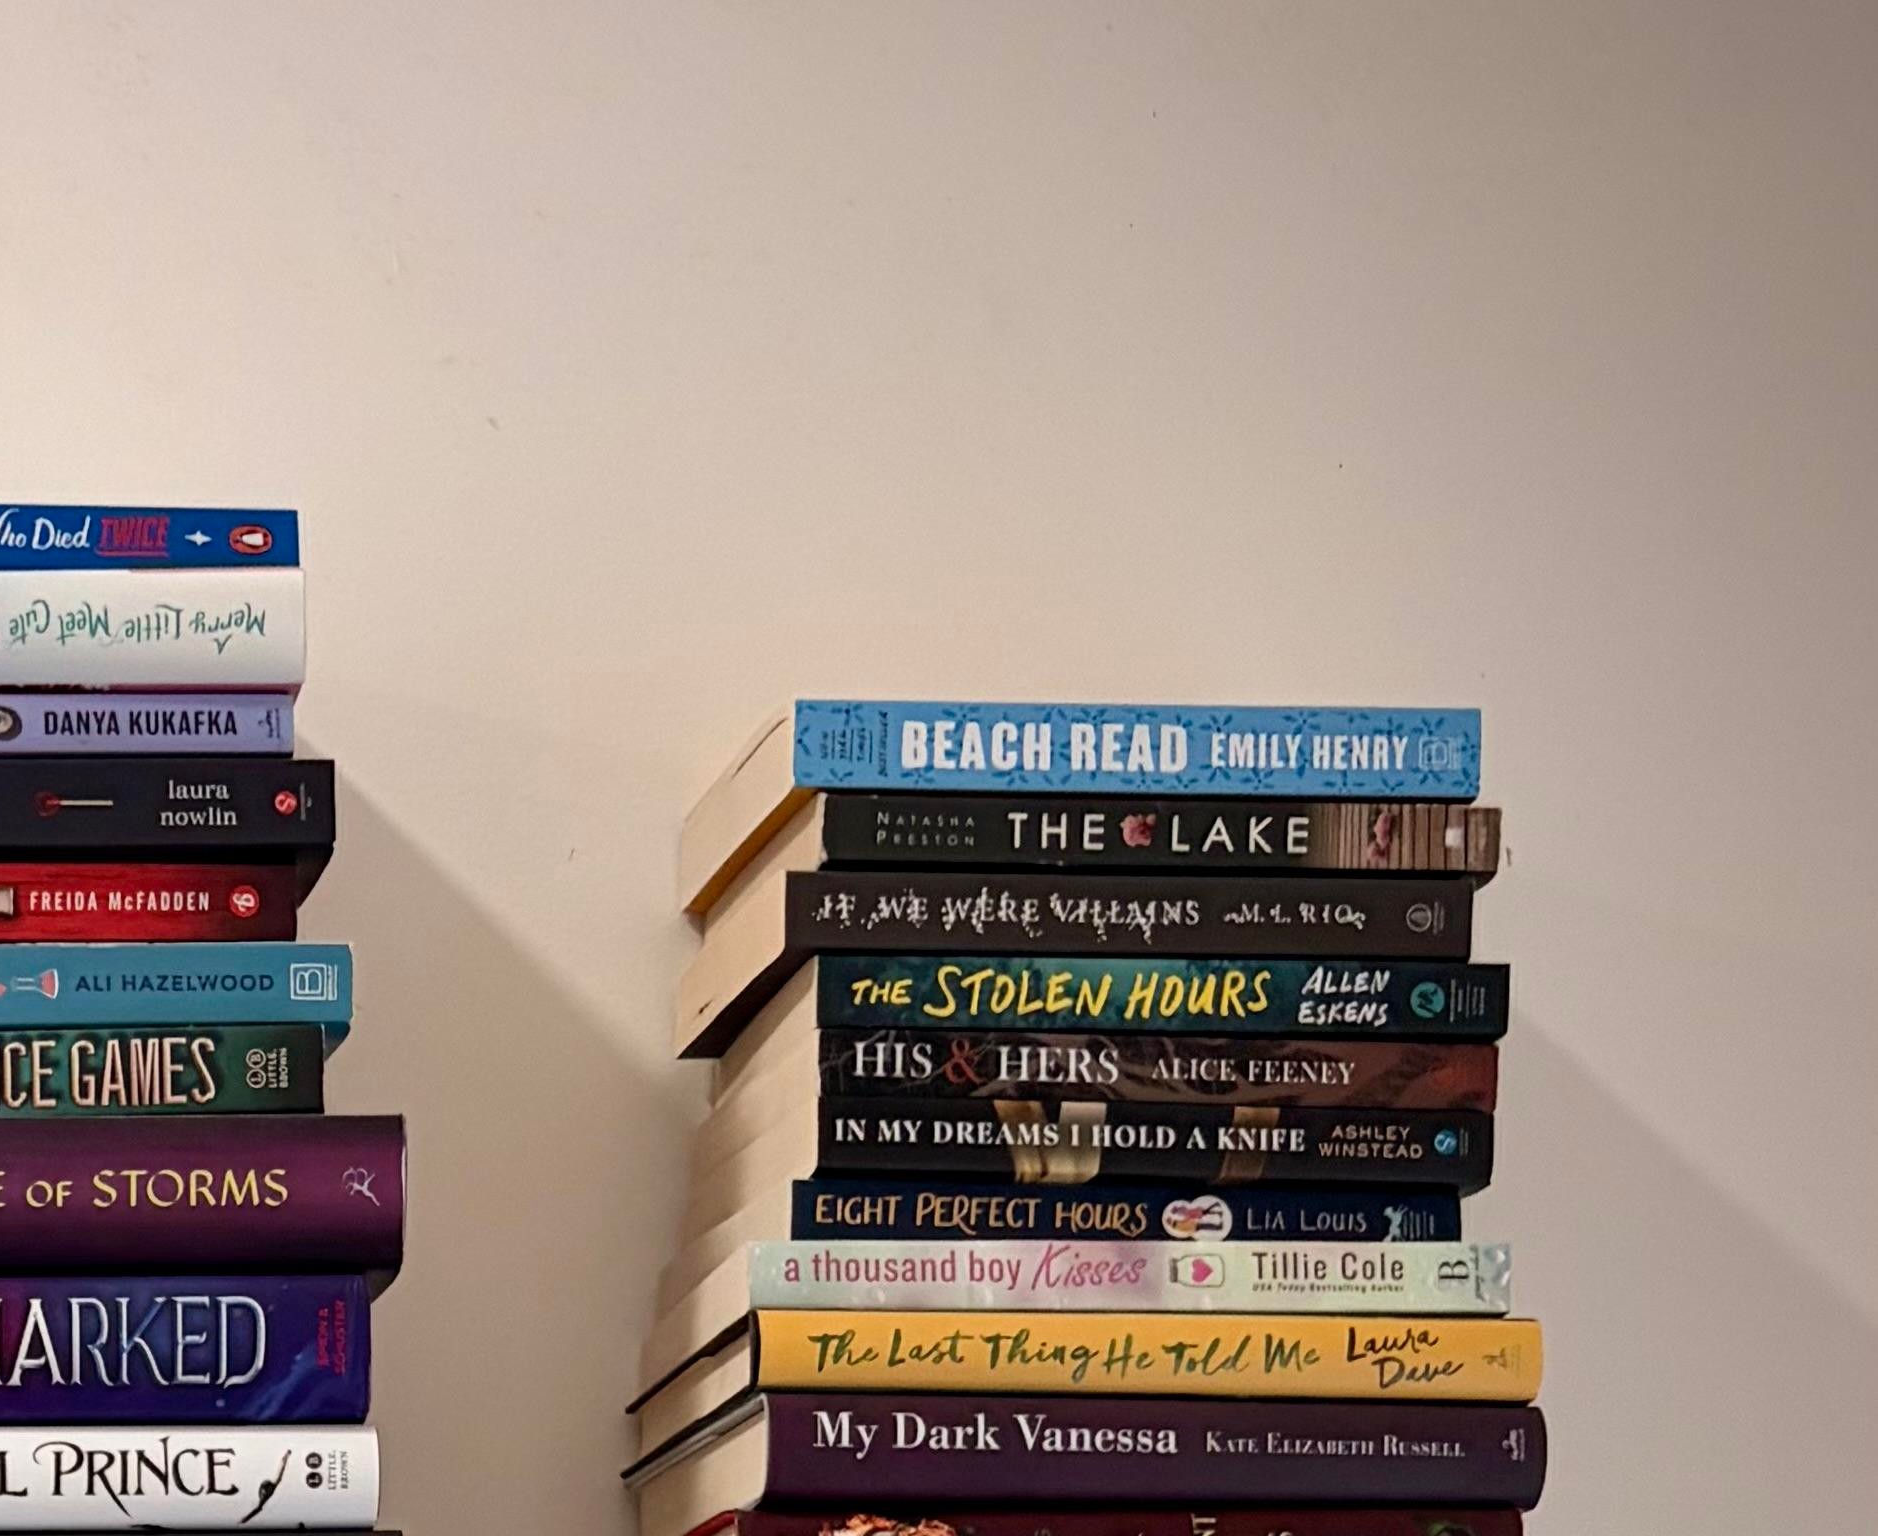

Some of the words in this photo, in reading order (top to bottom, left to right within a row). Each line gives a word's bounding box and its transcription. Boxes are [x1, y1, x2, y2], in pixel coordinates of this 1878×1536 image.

[44, 710, 122, 736] DANYA
[129, 709, 237, 735] KUKAFKA
[1212, 733, 1301, 770] EMILY
[1313, 737, 1407, 769] HENRY
[168, 780, 228, 800] laura
[161, 806, 237, 828] nowlin
[1008, 812, 1105, 851] THE
[1173, 816, 1310, 853] LAKE
[75, 974, 112, 992] ALI
[122, 973, 275, 992] HAZELWOOD
[852, 979, 912, 1007] THE
[924, 966, 1111, 1018] STOLEN
[1127, 970, 1271, 1016] HOURS
[1302, 968, 1389, 995] ALLEN
[1297, 999, 1388, 1027] ESKENS
[1152, 1059, 1237, 1082] ALICE
[1248, 1060, 1354, 1083] FEENEY
[835, 1119, 868, 1142] IN
[876, 1119, 925, 1145] MY
[934, 1120, 1059, 1145] DREAMS
[1070, 1123, 1081, 1146] I
[1092, 1124, 1176, 1148] HOLD
[1186, 1126, 1207, 1148] A
[1217, 1126, 1305, 1151] KNIFE
[1333, 1126, 1409, 1140] ASHLEY
[1319, 1142, 1423, 1158] WINSTEAD
[812, 1412, 878, 1459] My
[892, 1413, 999, 1450] Dark
[1013, 1416, 1176, 1454] Vanessa
